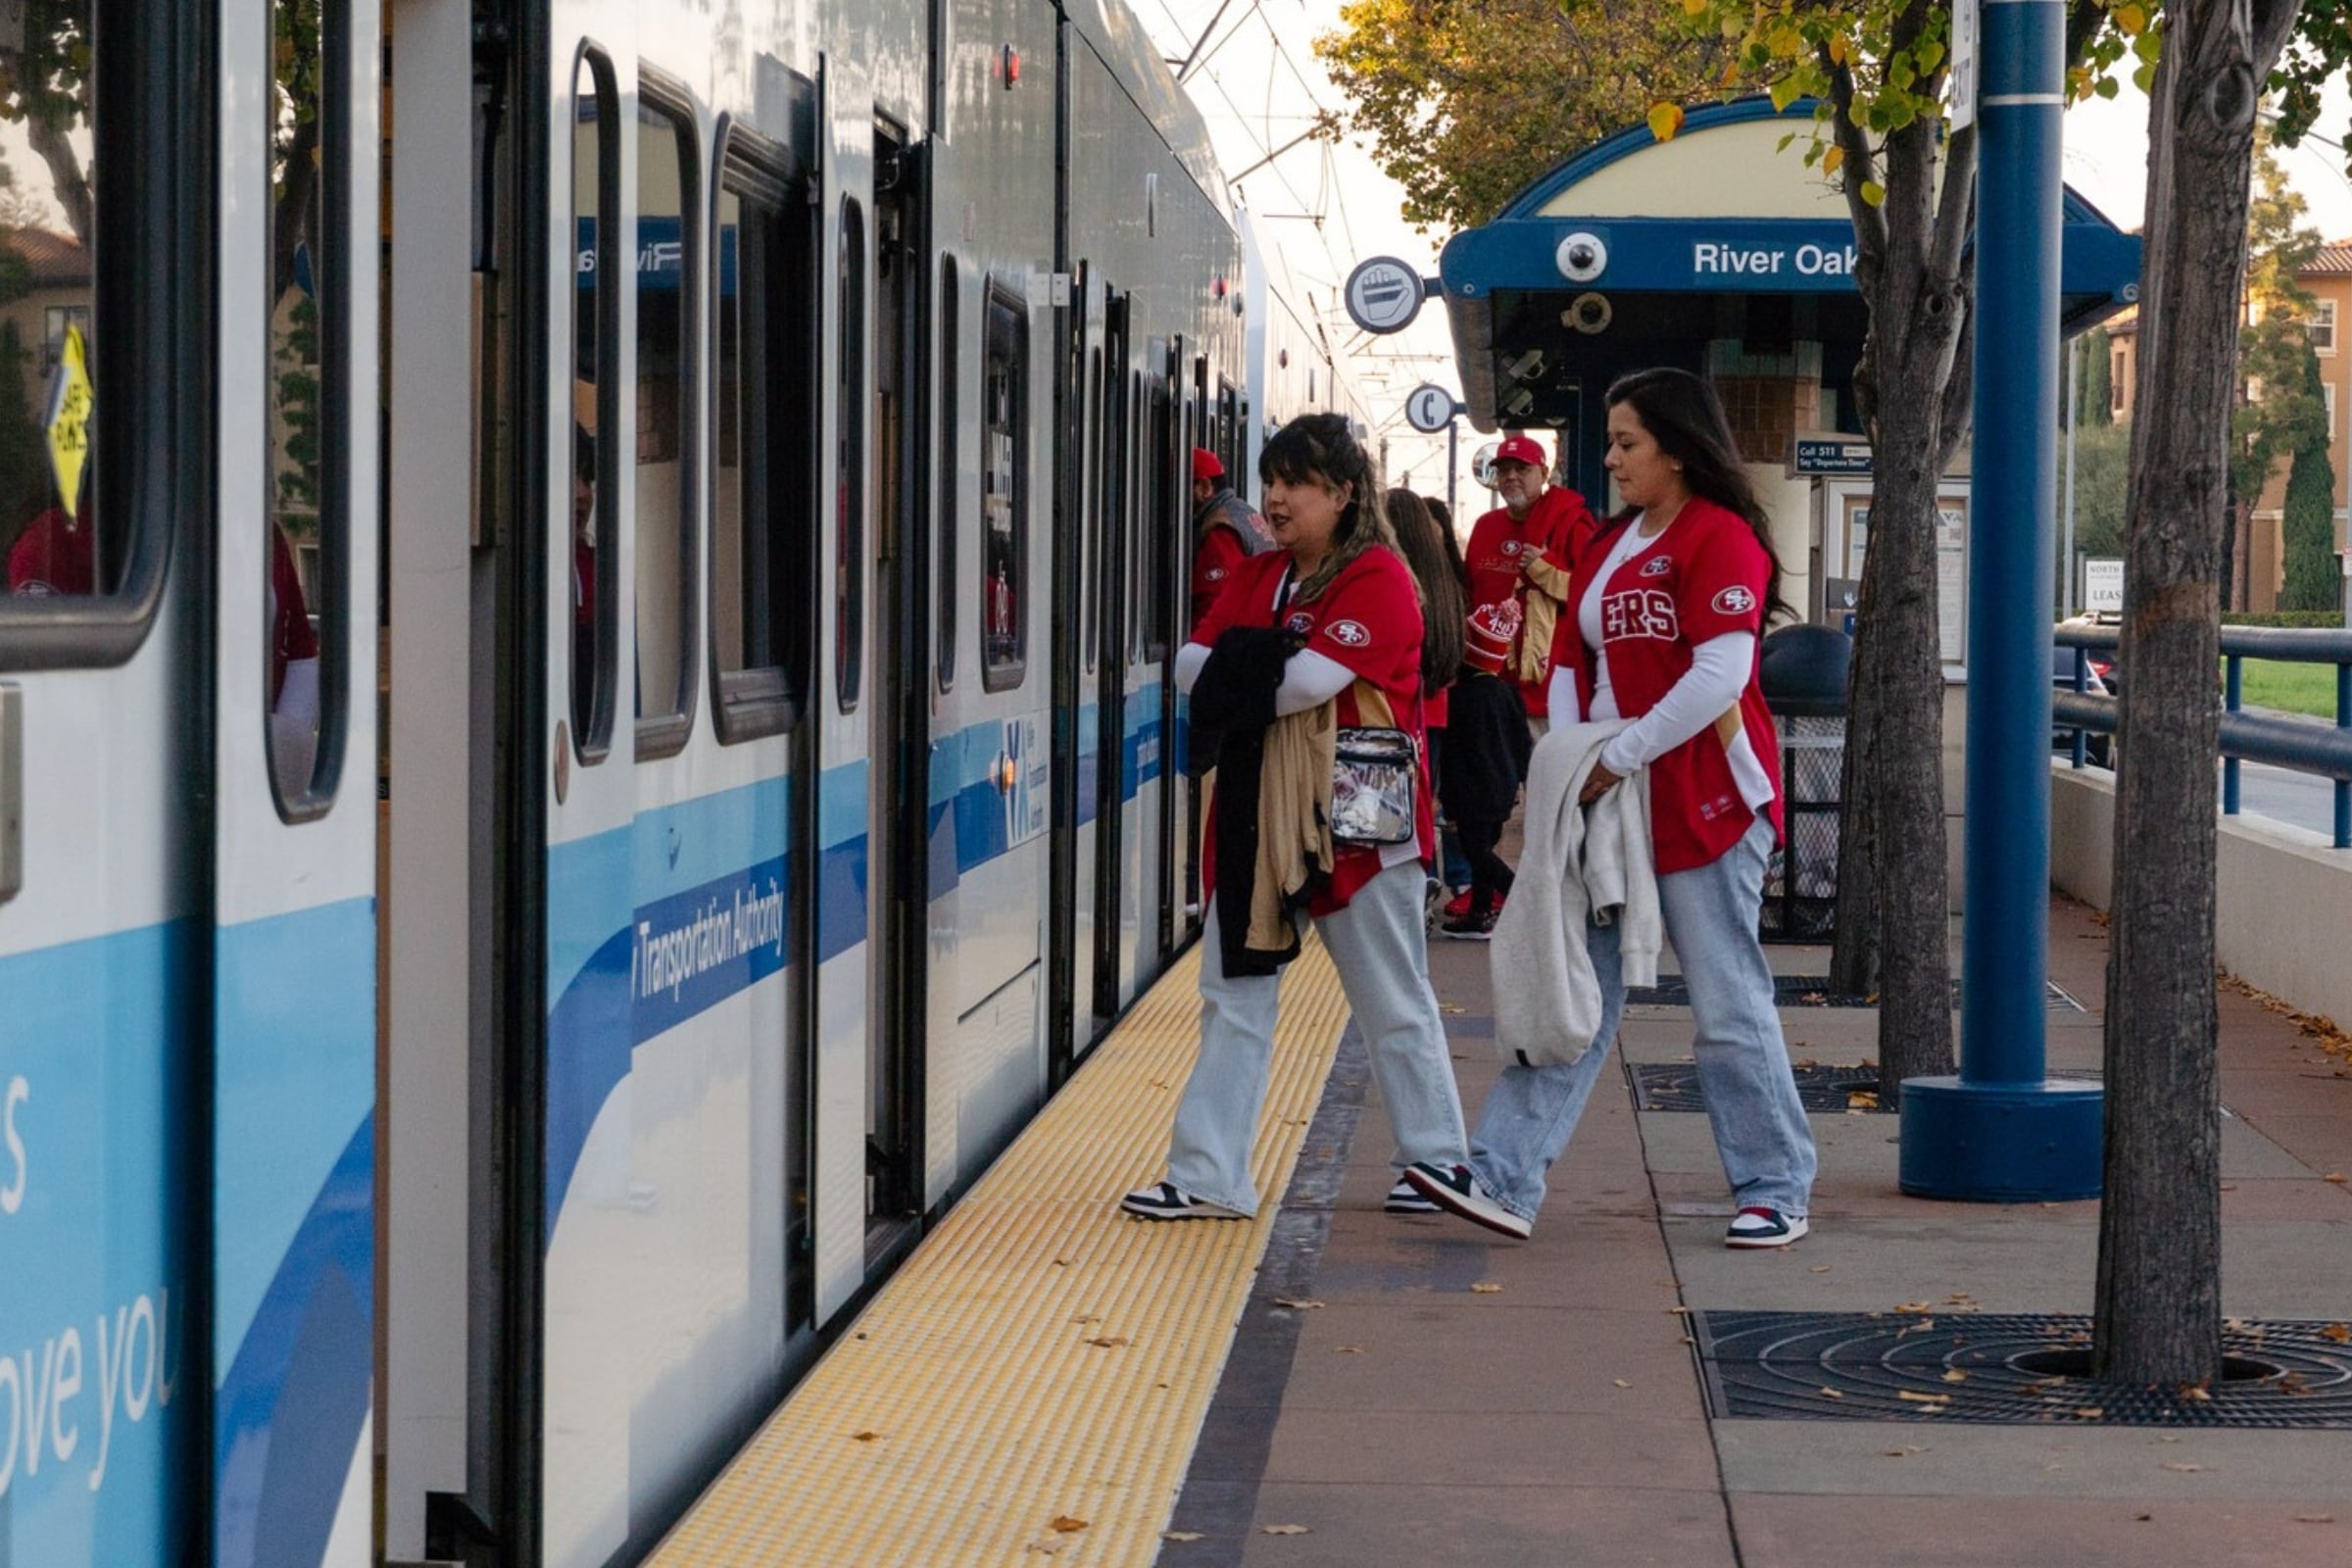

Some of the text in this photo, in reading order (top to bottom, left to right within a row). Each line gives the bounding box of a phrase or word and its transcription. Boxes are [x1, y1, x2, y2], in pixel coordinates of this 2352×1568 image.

[1693, 244, 1858, 274] River Oak
[1799, 447, 1816, 457] Call
[1818, 446, 1836, 457] 511
[1601, 589, 1680, 644] ERS
[639, 896, 736, 1003] Transportation
[734, 876, 785, 957] Authority
